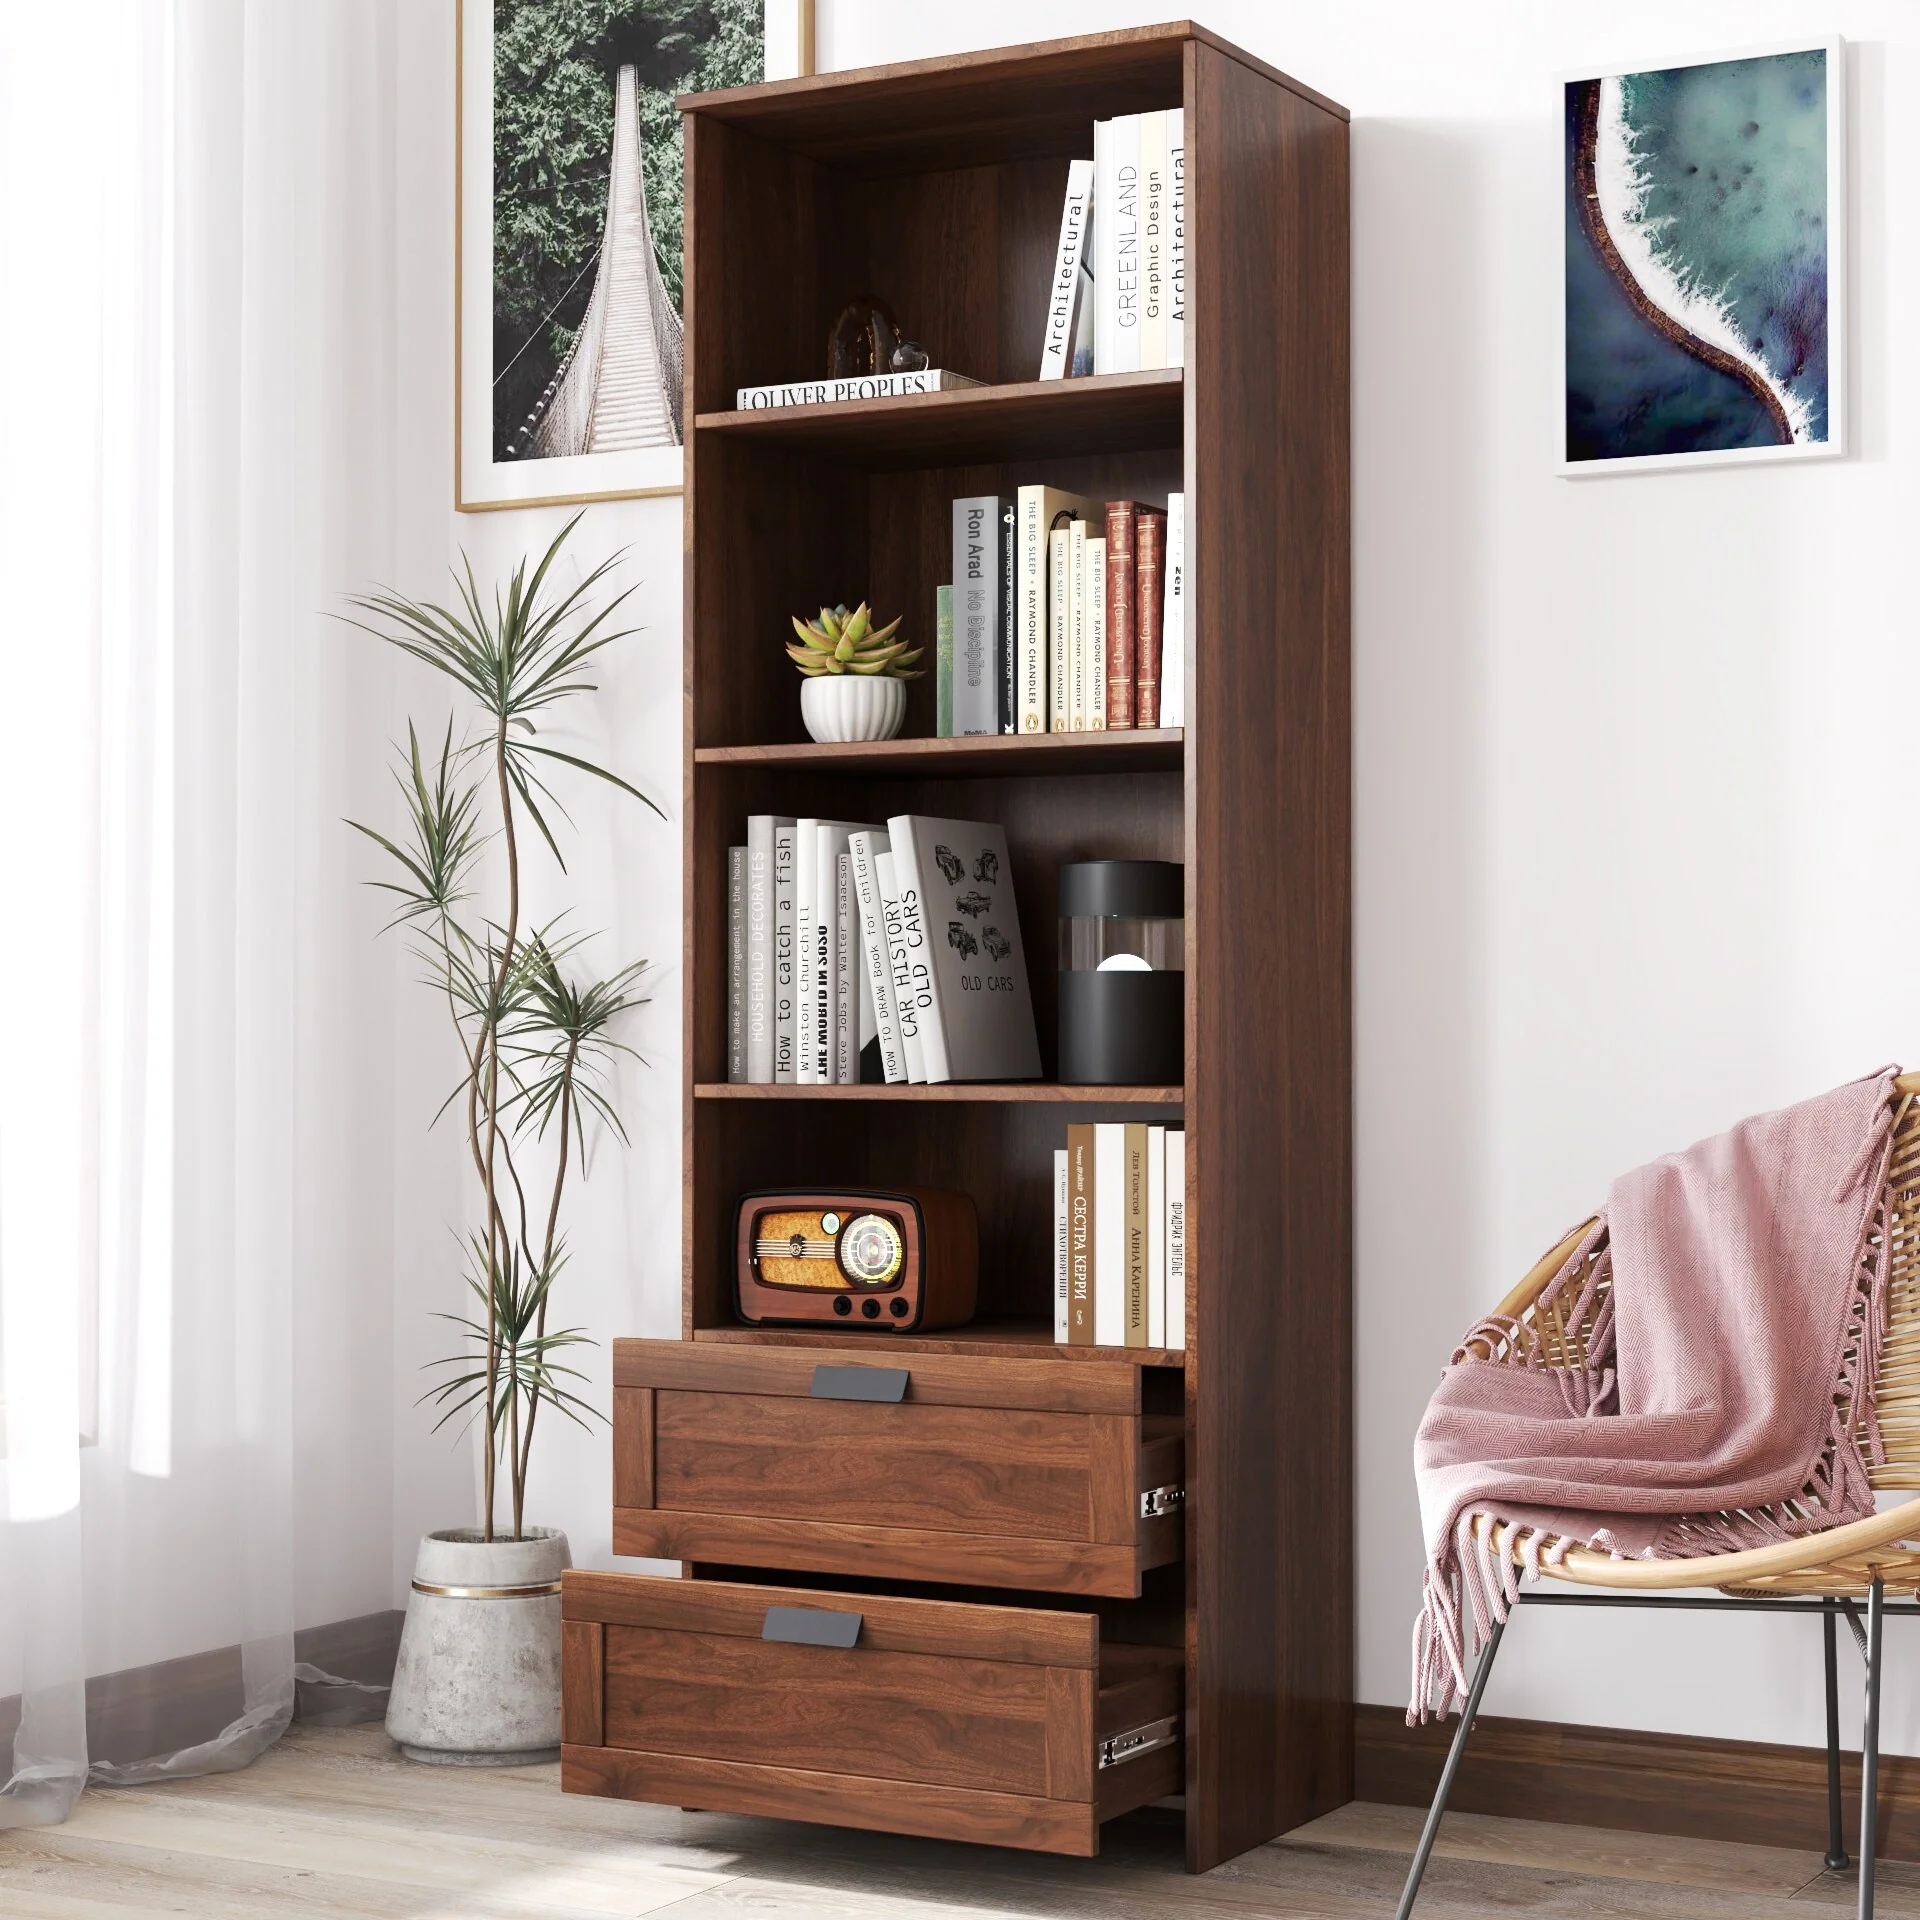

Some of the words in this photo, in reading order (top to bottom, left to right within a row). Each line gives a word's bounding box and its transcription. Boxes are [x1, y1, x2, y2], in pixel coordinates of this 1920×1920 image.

[1147, 170, 1162, 236] Design
[1118, 166, 1136, 328] GREENLAND
[1172, 147, 1184, 321] Architectural
[1048, 194, 1083, 354] Architectural
[1147, 244, 1162, 318] Graphic
[968, 508, 984, 539] Ron
[1028, 501, 1036, 520] THE
[1028, 524, 1036, 542] BIG
[968, 545, 984, 579] Arad
[1028, 546, 1036, 575] SLEEP
[1006, 578, 1013, 587] OF
[1174, 566, 1182, 596] zen
[968, 590, 985, 611] No
[1028, 590, 1036, 644] RAYMOND
[964, 617, 985, 687] Discipline
[1028, 649, 1036, 704] CHANDLER
[776, 838, 791, 885] fish
[856, 838, 871, 905] children
[752, 852, 764, 941] DECORATES
[838, 856, 848, 917] Isaacson
[733, 908, 740, 920] in
[780, 900, 791, 911] a
[865, 912, 876, 936] for
[901, 890, 922, 948] CARS
[733, 926, 742, 988] arrangement
[776, 925, 791, 985] catch
[800, 906, 810, 992] Churchill
[838, 926, 848, 972] Walter
[870, 944, 882, 977] Book
[883, 898, 910, 987] HISTORY
[734, 994, 740, 1005] an
[752, 952, 764, 1042] HOUSEHOLD
[838, 980, 850, 994] by
[876, 985, 889, 1018] DRAW
[913, 964, 932, 1008] OLD
[962, 974, 982, 992] OLD
[987, 976, 1014, 992] CARS
[778, 999, 791, 1022] to
[838, 1002, 848, 1032] Jobs
[900, 999, 917, 1037] CAR
[733, 1040, 740, 1050] to
[800, 1003, 810, 1072] Winston
[882, 1026, 892, 1043] TO
[777, 1036, 791, 1072] How
[838, 1041, 848, 1078] Steve
[887, 1051, 898, 1076] HOW
[1074, 1196, 1086, 1250] СЕСТРА
[1170, 1202, 1184, 1239] ФРИДРИХ
[1074, 1254, 1086, 1300] КЕРРИ
[1171, 1243, 1183, 1276] ЭНГЕЛЬС
